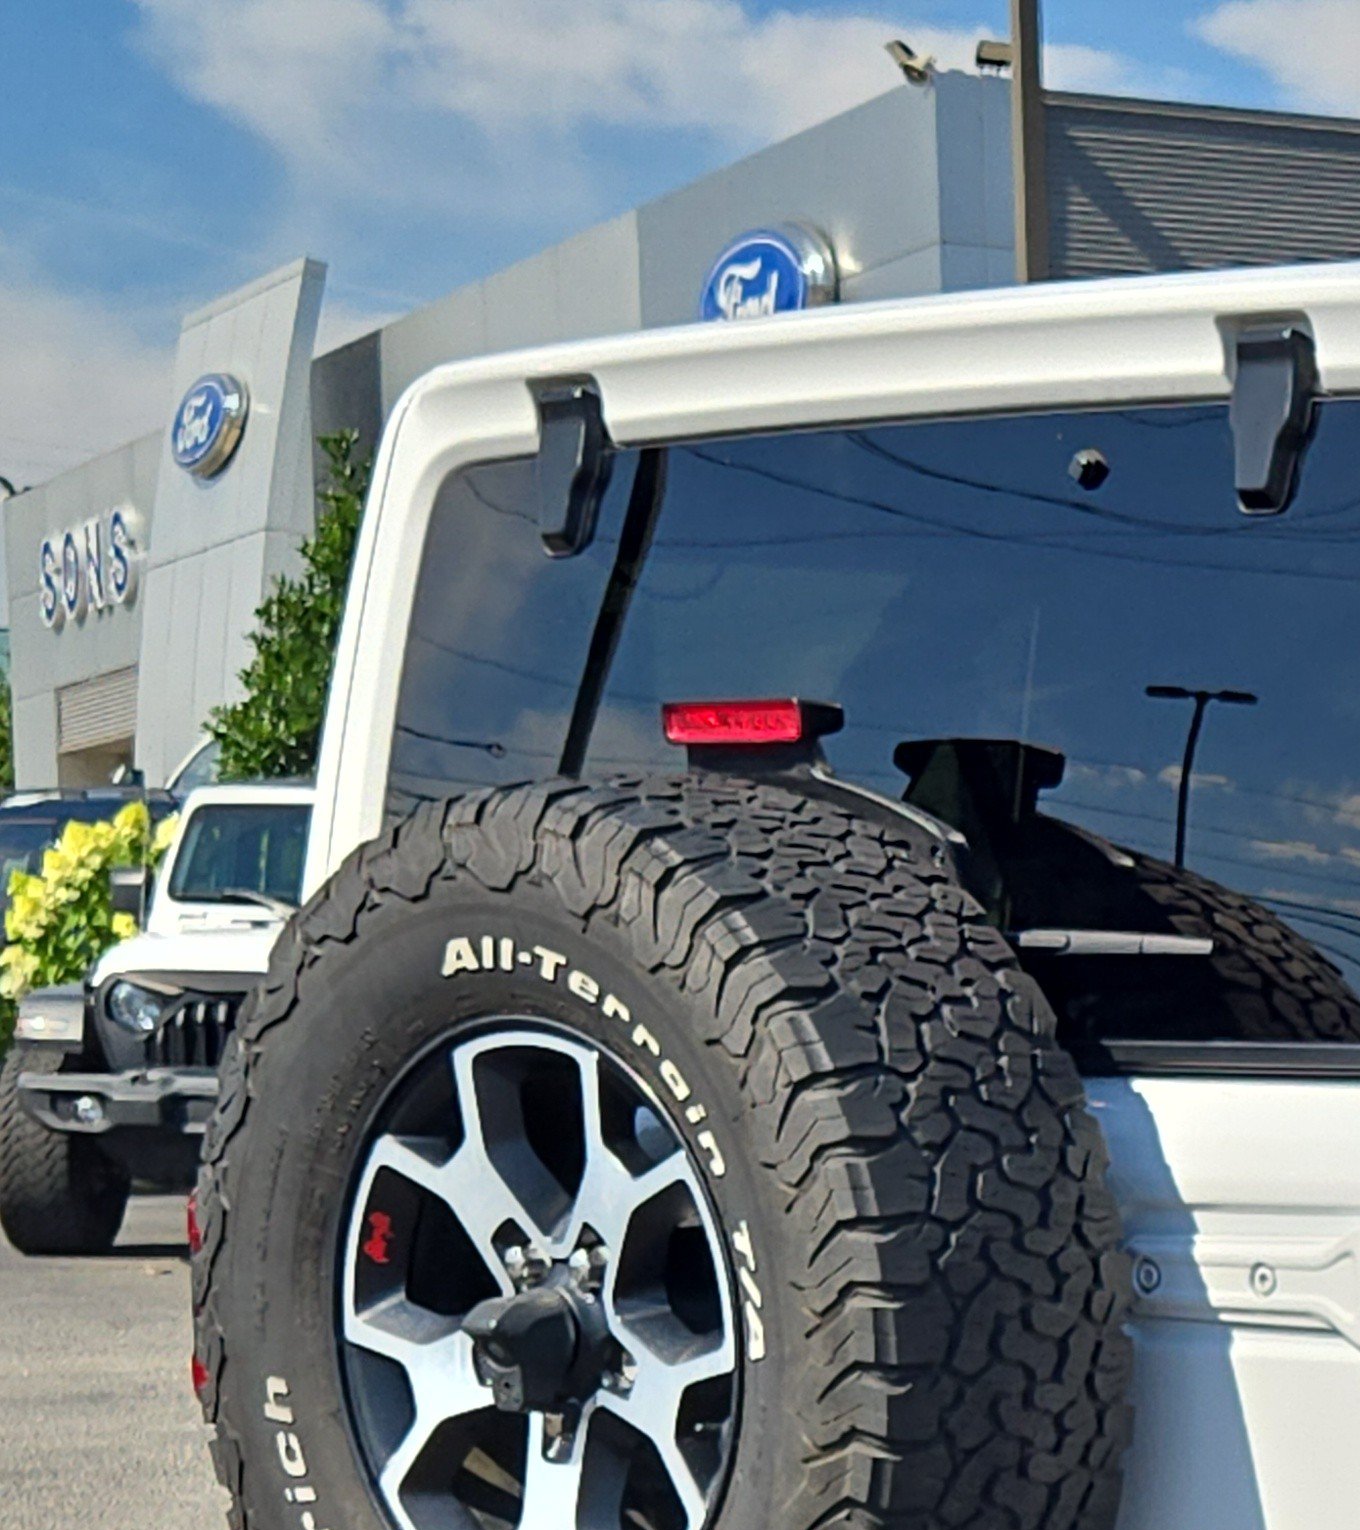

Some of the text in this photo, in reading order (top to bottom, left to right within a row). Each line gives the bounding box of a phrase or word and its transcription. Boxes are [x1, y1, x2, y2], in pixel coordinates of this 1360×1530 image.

[40, 509, 131, 628] SONS
[442, 935, 767, 1362] All-Terrain T/A
